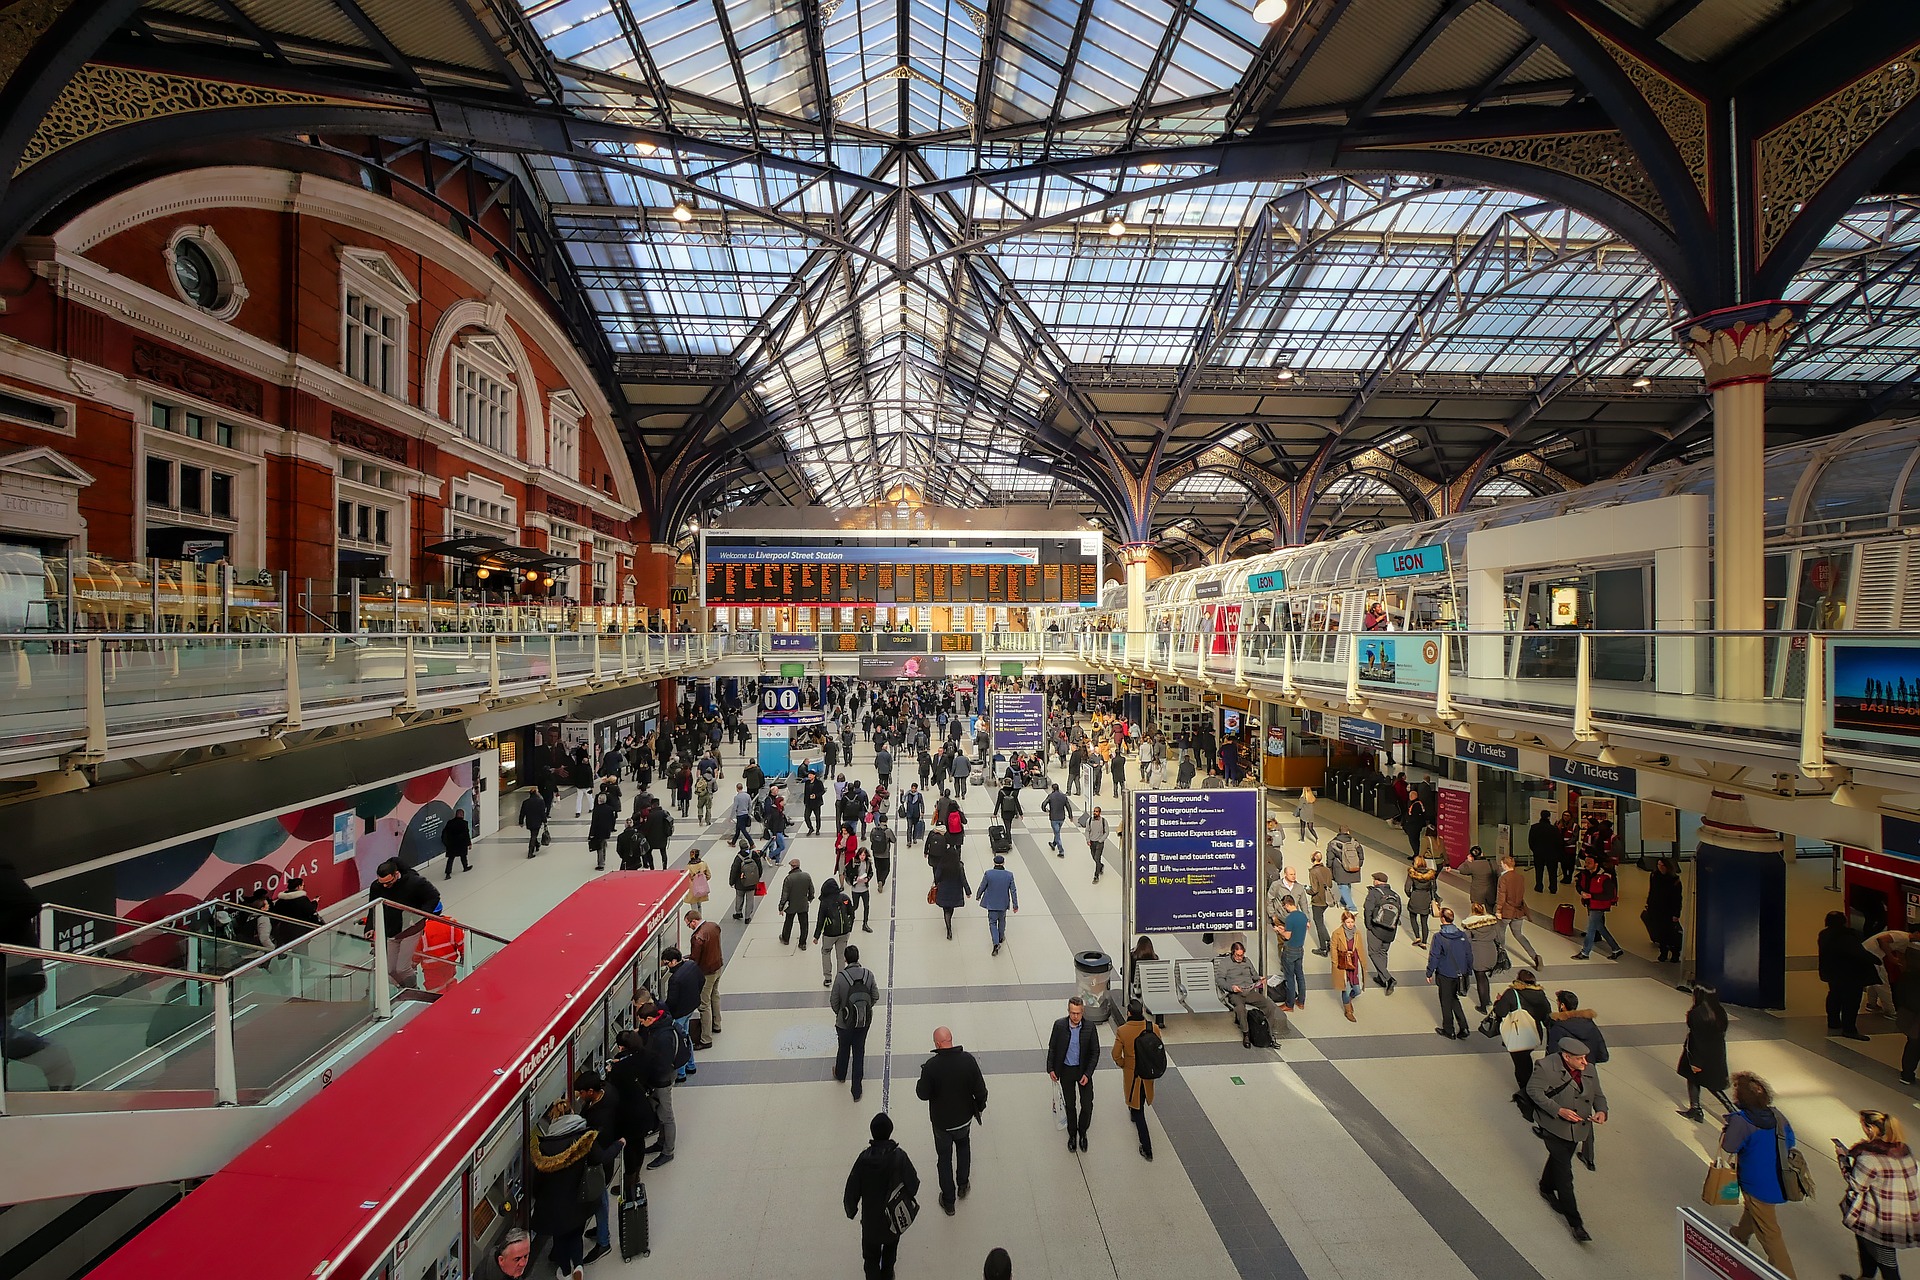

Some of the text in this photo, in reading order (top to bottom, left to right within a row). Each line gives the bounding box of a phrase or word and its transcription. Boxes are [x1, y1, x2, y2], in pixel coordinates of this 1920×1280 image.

[4, 496, 65, 517] HOTEL
[756, 551, 790, 560] Liverpool
[791, 551, 814, 559] Street
[815, 551, 843, 559] Station
[1393, 553, 1424, 572] LEON
[1257, 575, 1274, 589] LEON
[81, 590, 110, 600] ESPRESSO
[1301, 709, 1308, 721] 10
[1479, 743, 1506, 758] Tickets
[1581, 763, 1619, 781] Tickets
[1160, 795, 1201, 803] Underground
[1189, 830, 1214, 838] Express
[1211, 840, 1233, 848] Tickets
[1198, 911, 1216, 919] Cycle
[647, 912, 661, 934] Tickets
[1206, 922, 1233, 930] Luggage
[519, 1043, 549, 1083] Tickets
[1686, 1225, 1713, 1249] Planned
[1713, 1248, 1738, 1268] service
[1686, 1233, 1720, 1262] alterations
